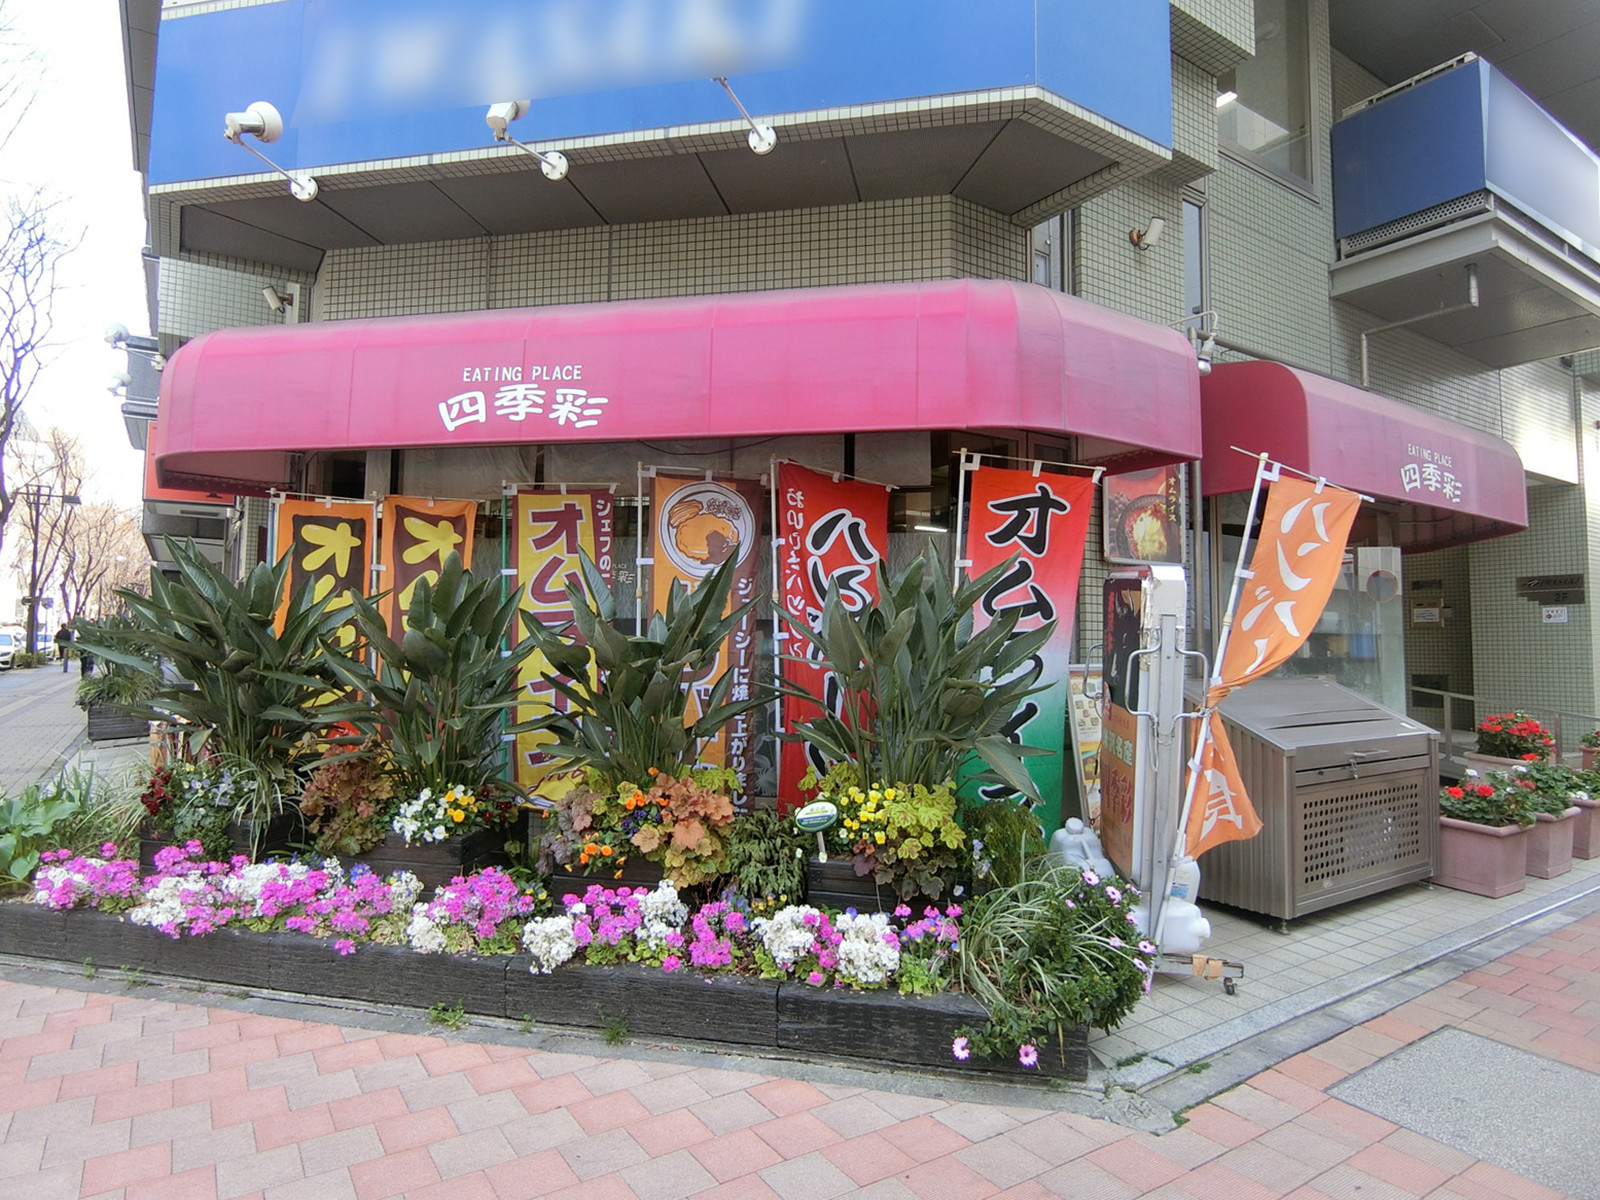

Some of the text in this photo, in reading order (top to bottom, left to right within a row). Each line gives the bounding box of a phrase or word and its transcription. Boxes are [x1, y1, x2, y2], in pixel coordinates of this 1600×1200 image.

[462, 364, 583, 382] EATING PLACE
[437, 383, 609, 432] 四季彩
[1407, 443, 1453, 468] EATING PLACE
[1168, 476, 1177, 522] オムライス
[1400, 462, 1463, 503] 四季彩
